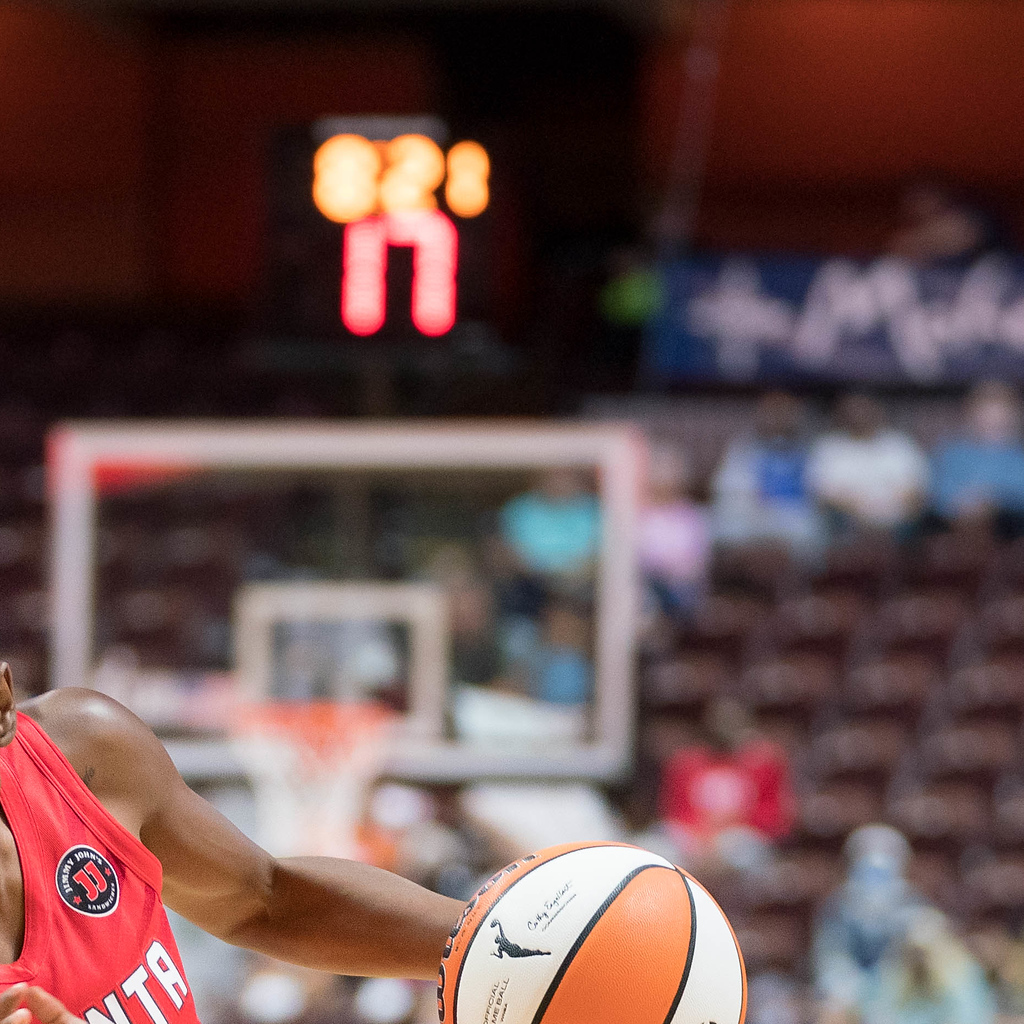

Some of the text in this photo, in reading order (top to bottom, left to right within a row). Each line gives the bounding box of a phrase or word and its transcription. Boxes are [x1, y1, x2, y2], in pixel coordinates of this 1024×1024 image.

[61, 850, 103, 893] JIMMY JOHN'S
[72, 860, 107, 902] JJ
[496, 978, 509, 1006] BALL
